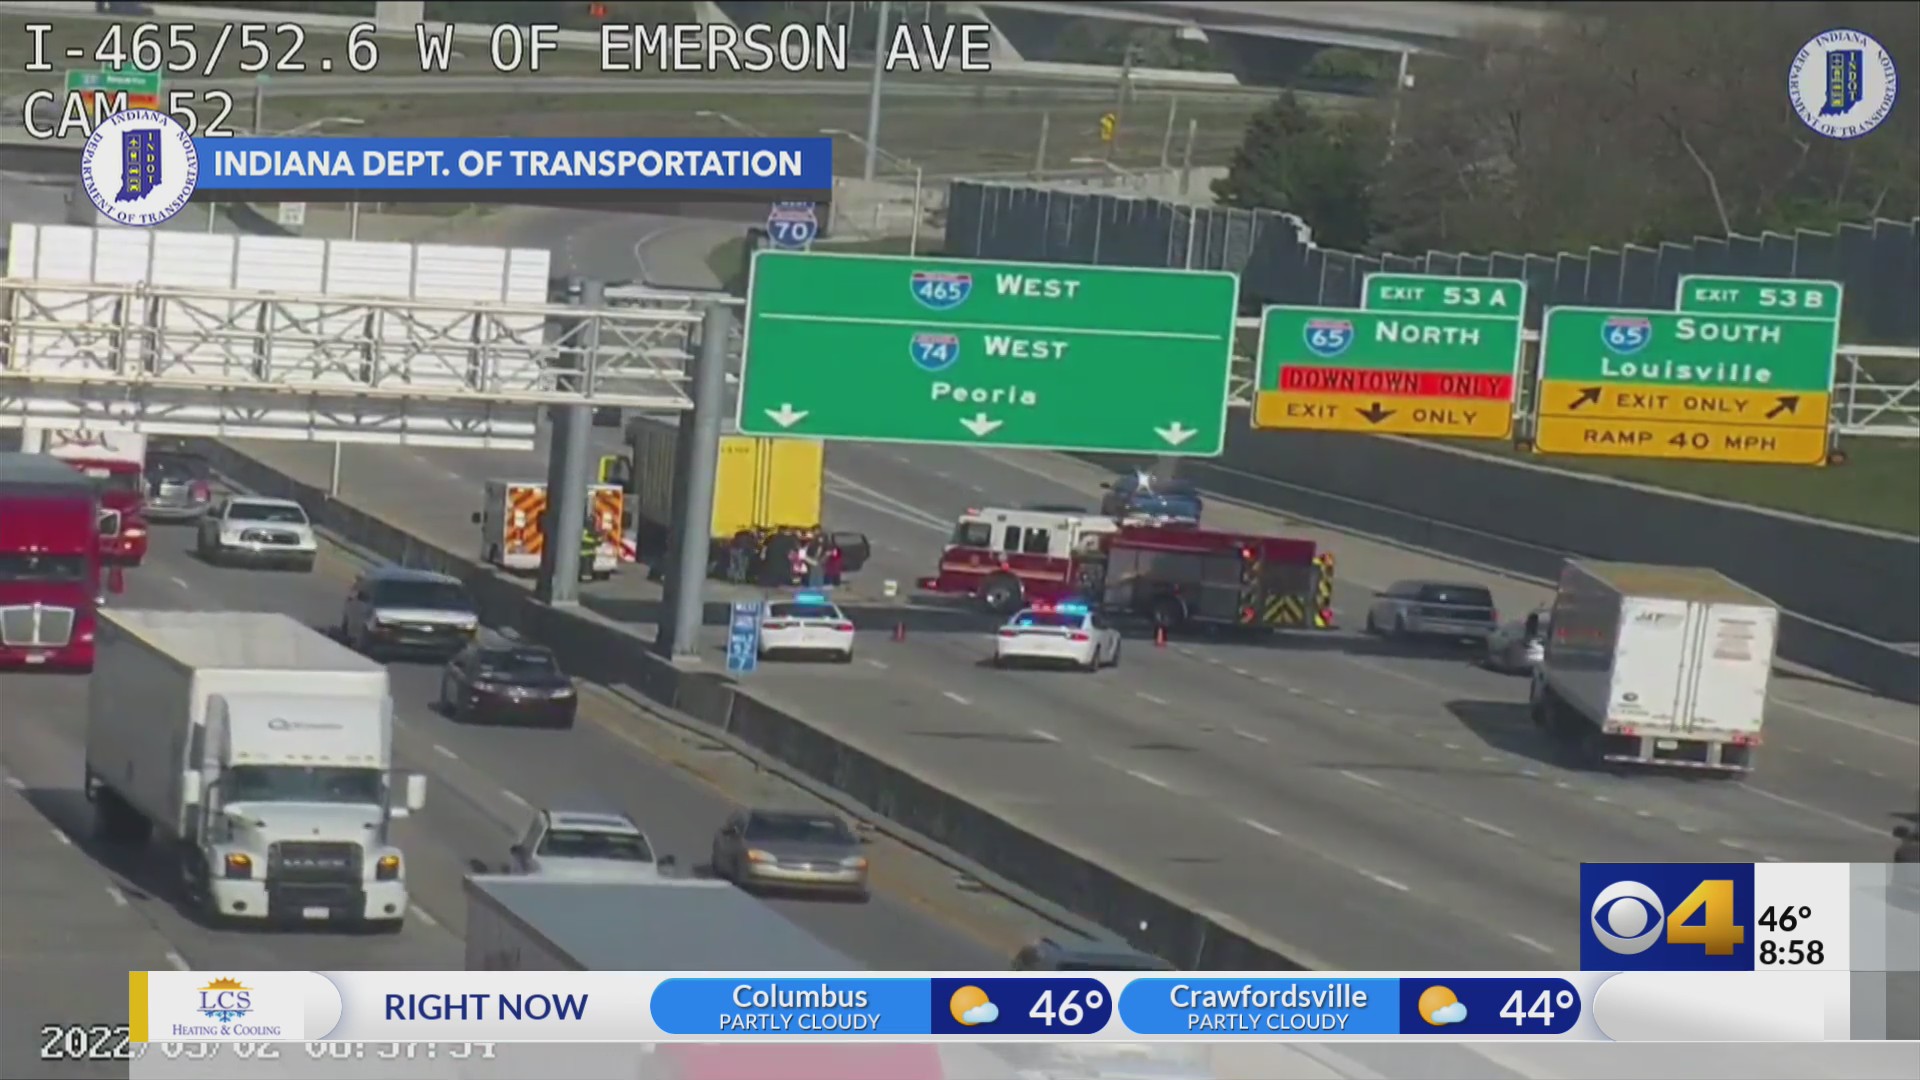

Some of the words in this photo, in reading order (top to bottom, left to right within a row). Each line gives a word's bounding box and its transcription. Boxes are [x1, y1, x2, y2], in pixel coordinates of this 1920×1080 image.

[775, 221, 808, 240] 70
[919, 280, 961, 300] 465
[996, 273, 1080, 299] WEST
[1380, 286, 1424, 300] EXIT
[1695, 288, 1739, 303] EXIT
[1311, 329, 1344, 347] 65
[1375, 321, 1480, 346] NORTH
[1609, 327, 1643, 345] 65
[1675, 318, 1781, 344] SOUTH
[919, 343, 948, 361] 74
[984, 334, 1068, 360] WEST
[1289, 367, 1418, 394] DOWNTOWN
[1440, 373, 1502, 396] ONLY
[1601, 357, 1772, 383] Louisville
[931, 381, 1037, 406] Peoria
[1616, 393, 1668, 410] EXIT
[1683, 396, 1749, 413] ONLY
[1287, 403, 1339, 418] EXIT
[1413, 409, 1477, 425] ONLY
[1584, 429, 1653, 446] RAMP
[1668, 432, 1710, 450] 40
[1725, 436, 1777, 451] MPH
